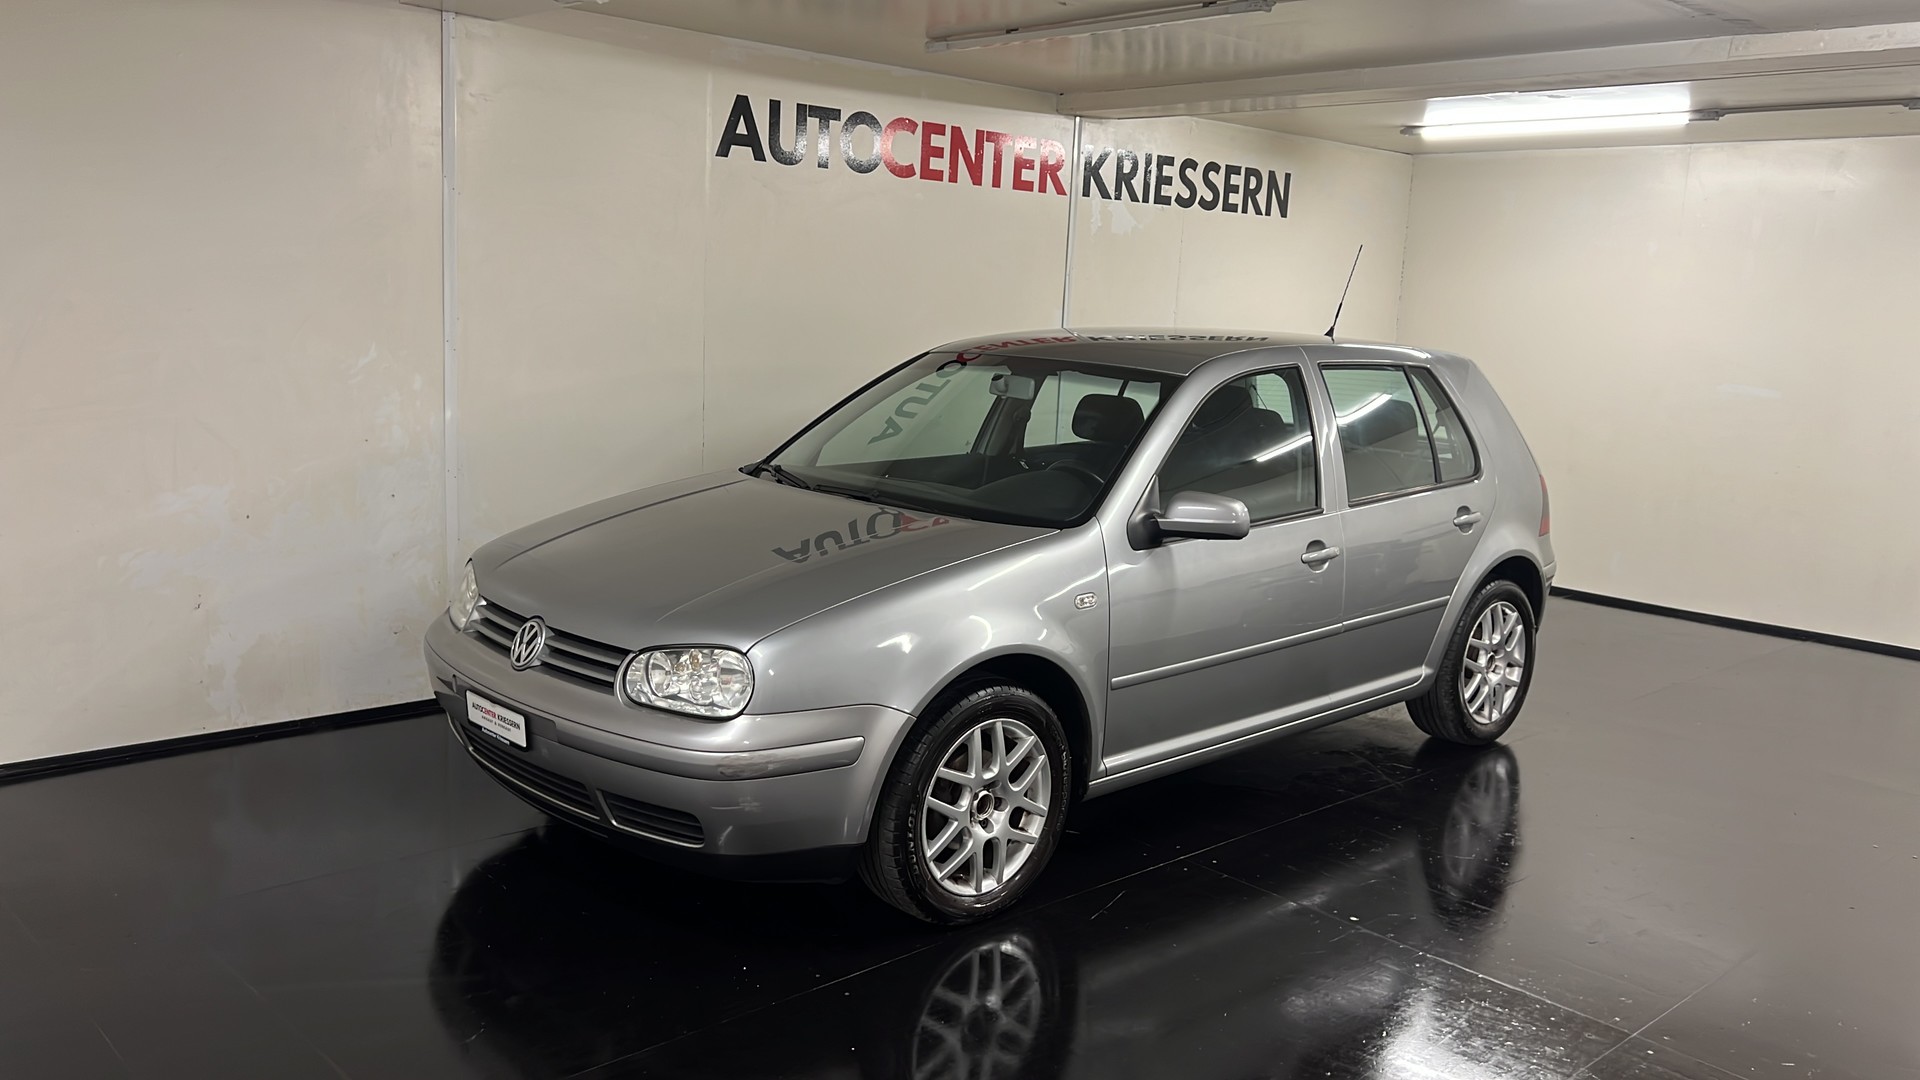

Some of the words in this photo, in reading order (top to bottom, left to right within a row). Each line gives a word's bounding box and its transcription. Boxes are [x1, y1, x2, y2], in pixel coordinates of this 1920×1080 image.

[715, 94, 1067, 196] AUTOCENTER
[1081, 144, 1292, 219] KRIESSERN
[511, 621, 542, 667] VW
[472, 702, 497, 719] AUTOCENTER
[497, 714, 521, 730] KRIESSERN
[907, 804, 919, 875] DUNLOP
